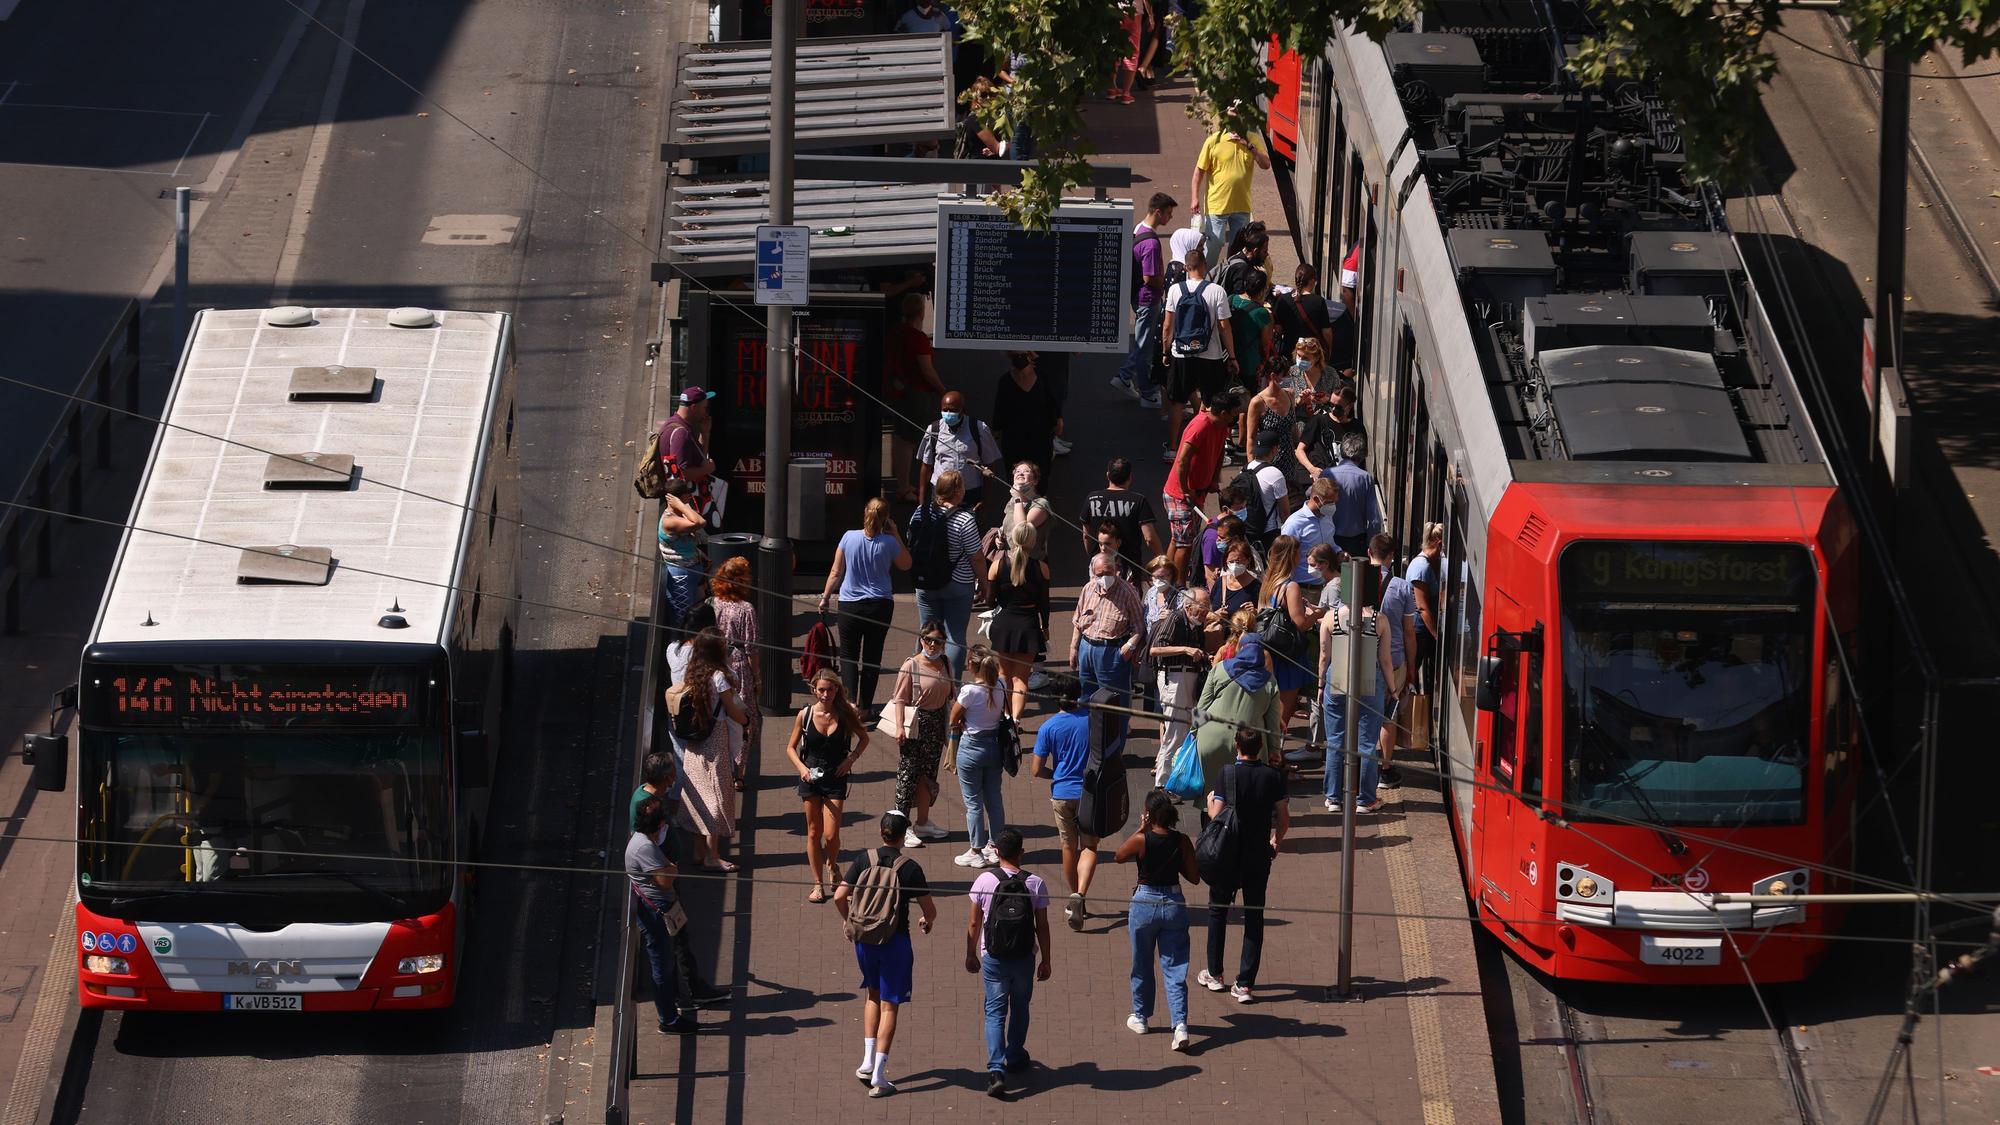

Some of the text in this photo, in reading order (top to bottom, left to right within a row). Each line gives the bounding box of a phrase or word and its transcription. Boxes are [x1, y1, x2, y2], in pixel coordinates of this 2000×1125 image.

[973, 295, 1006, 303] Bensberg
[732, 458, 762, 472] AB
[825, 481, 844, 494] ÖLN
[1090, 500, 1135, 517] RAW
[113, 678, 407, 714] 146 Nicht einsteigen
[1662, 948, 1705, 960] 4022
[228, 960, 302, 976] MAN
[236, 996, 296, 1009] K VB 512
